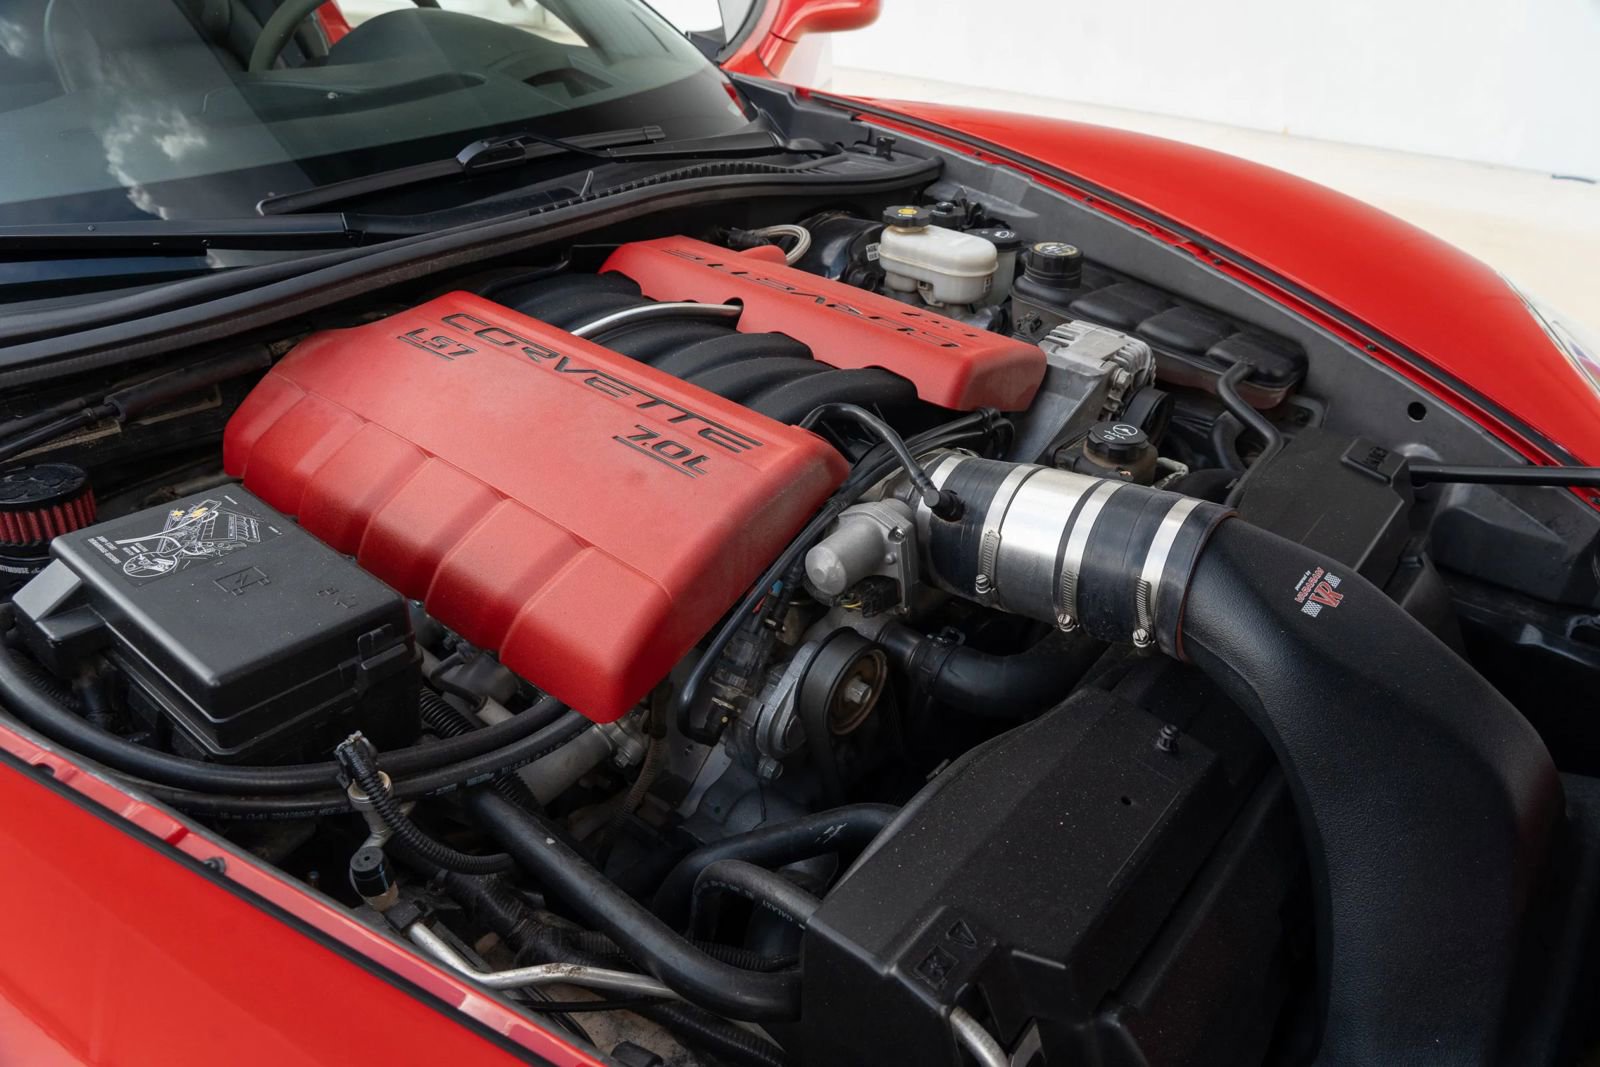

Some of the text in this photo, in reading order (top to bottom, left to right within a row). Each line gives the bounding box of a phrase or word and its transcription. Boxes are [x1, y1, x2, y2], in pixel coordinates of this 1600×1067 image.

[404, 327, 479, 358] LS7
[441, 312, 764, 454] CORVETTE
[625, 424, 710, 475] 7.0L
